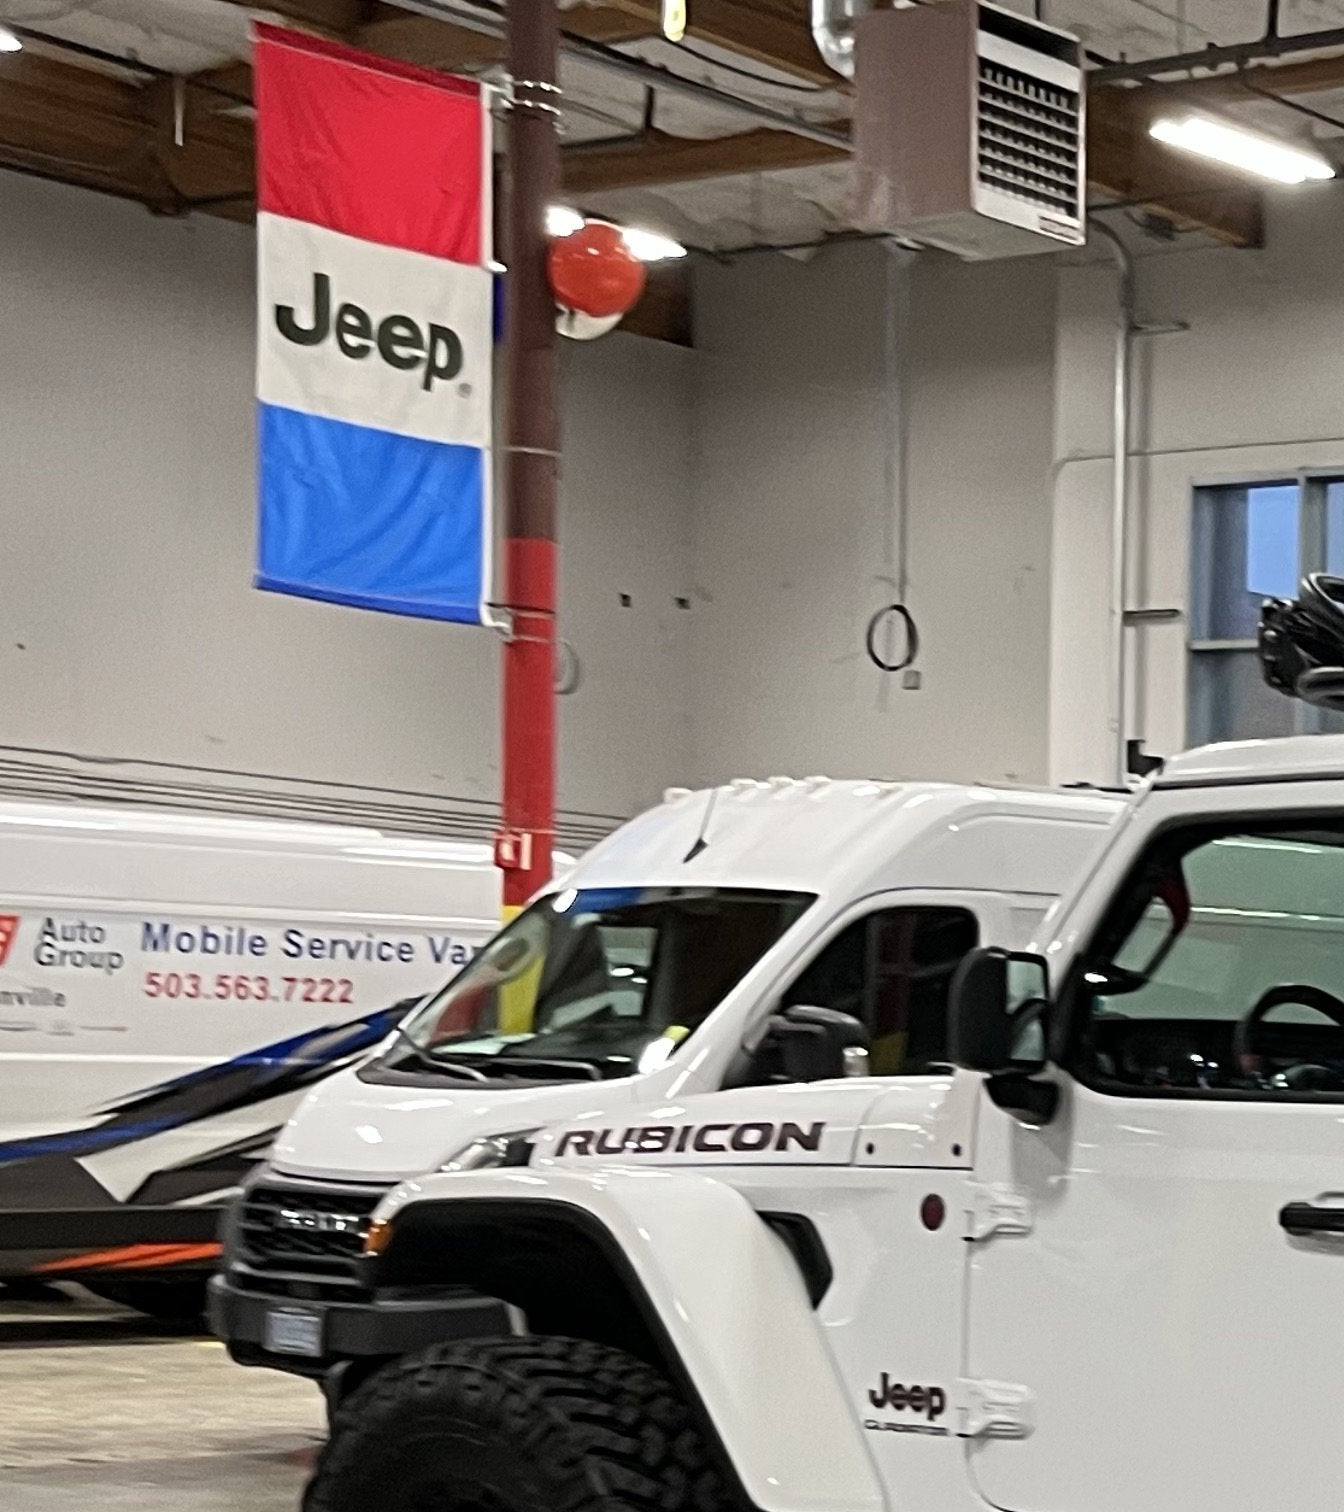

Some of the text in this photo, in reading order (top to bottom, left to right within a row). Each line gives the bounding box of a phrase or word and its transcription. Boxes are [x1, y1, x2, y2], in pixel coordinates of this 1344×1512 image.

[274, 271, 464, 392] Jeep
[34, 941, 125, 976] Group
[38, 917, 107, 944] Auto
[141, 921, 267, 957] Mobile
[281, 928, 415, 963] Service
[144, 972, 353, 1003] 503.563.7222
[554, 1121, 826, 1157] RUBICON
[868, 1371, 946, 1422] Jeep
